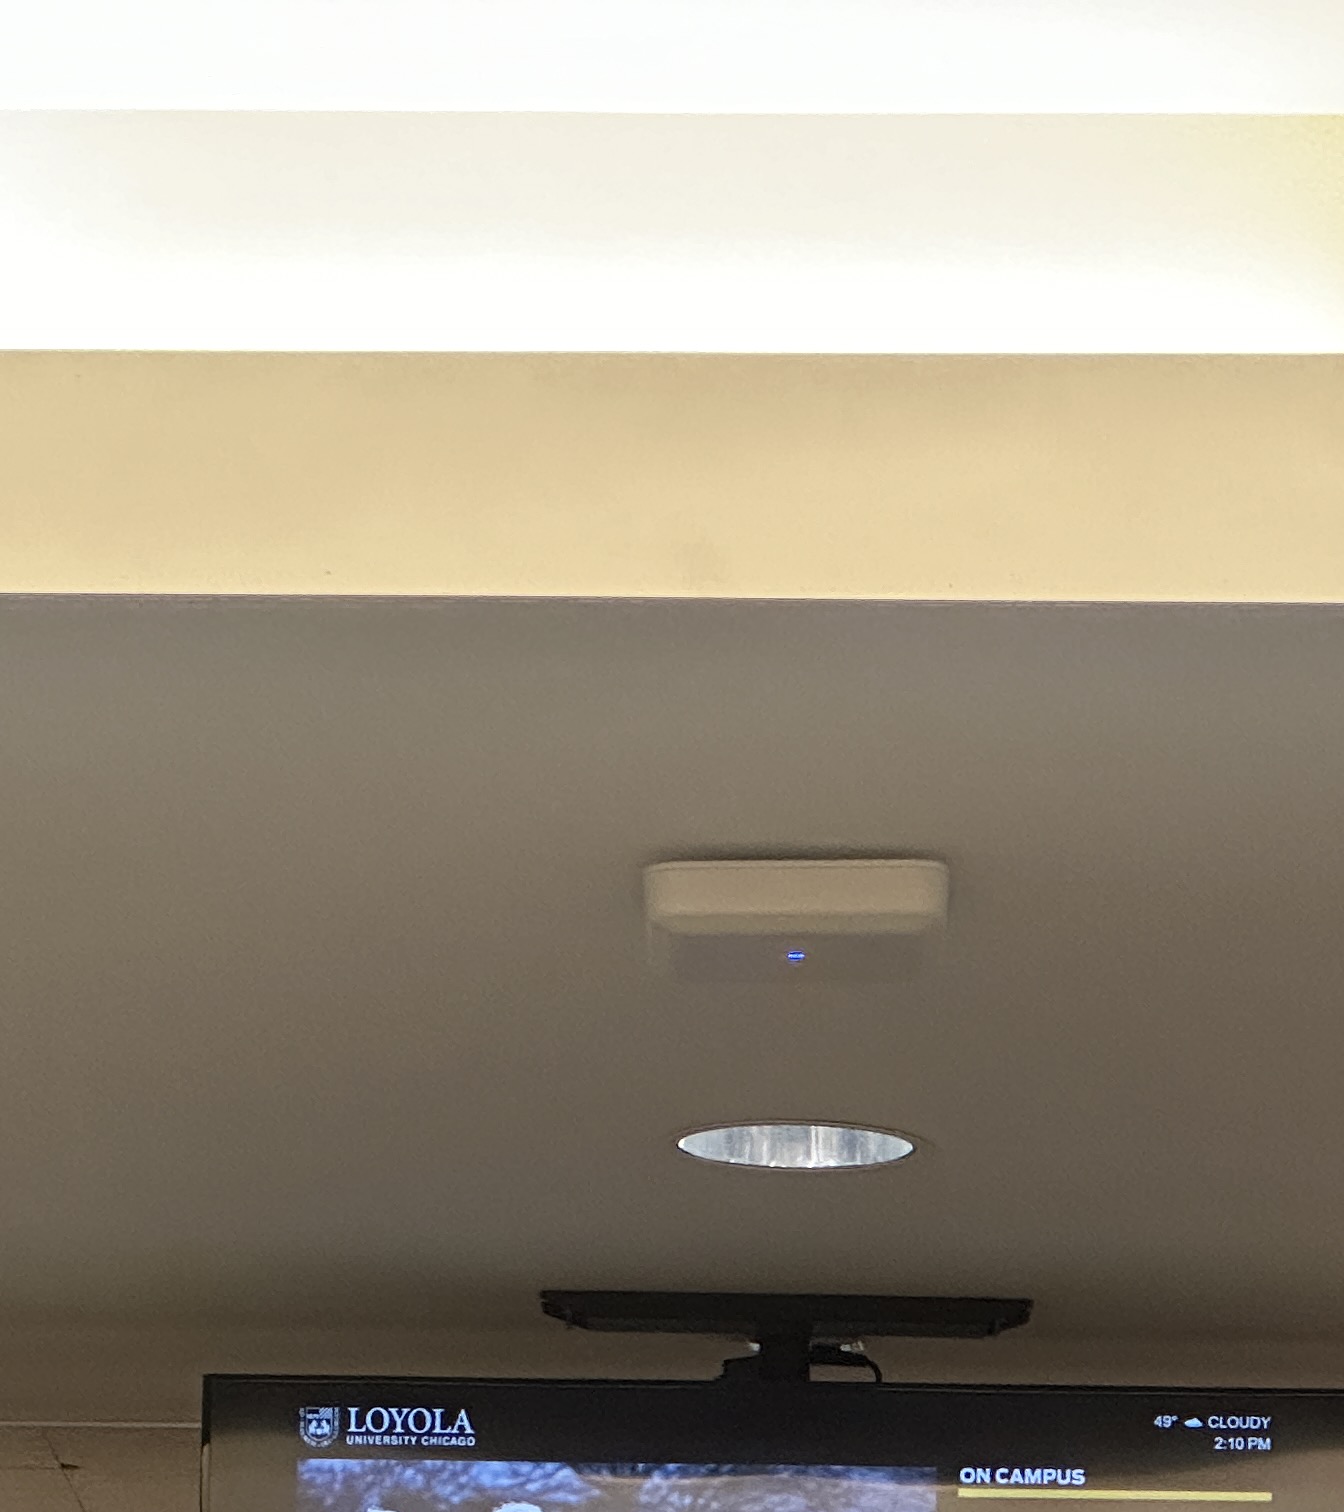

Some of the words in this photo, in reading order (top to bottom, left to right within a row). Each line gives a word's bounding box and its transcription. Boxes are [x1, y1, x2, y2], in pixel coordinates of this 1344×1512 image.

[347, 1407, 475, 1433] LOYOLA
[1208, 1416, 1271, 1429] CLOUDY
[346, 1435, 417, 1446] UNIVERSITY
[421, 1436, 476, 1446] CHICAGO
[1214, 1436, 1244, 1450] 2:10
[1247, 1437, 1271, 1450] PM
[959, 1467, 990, 1483] ON
[995, 1468, 1086, 1485] CAMPUS
